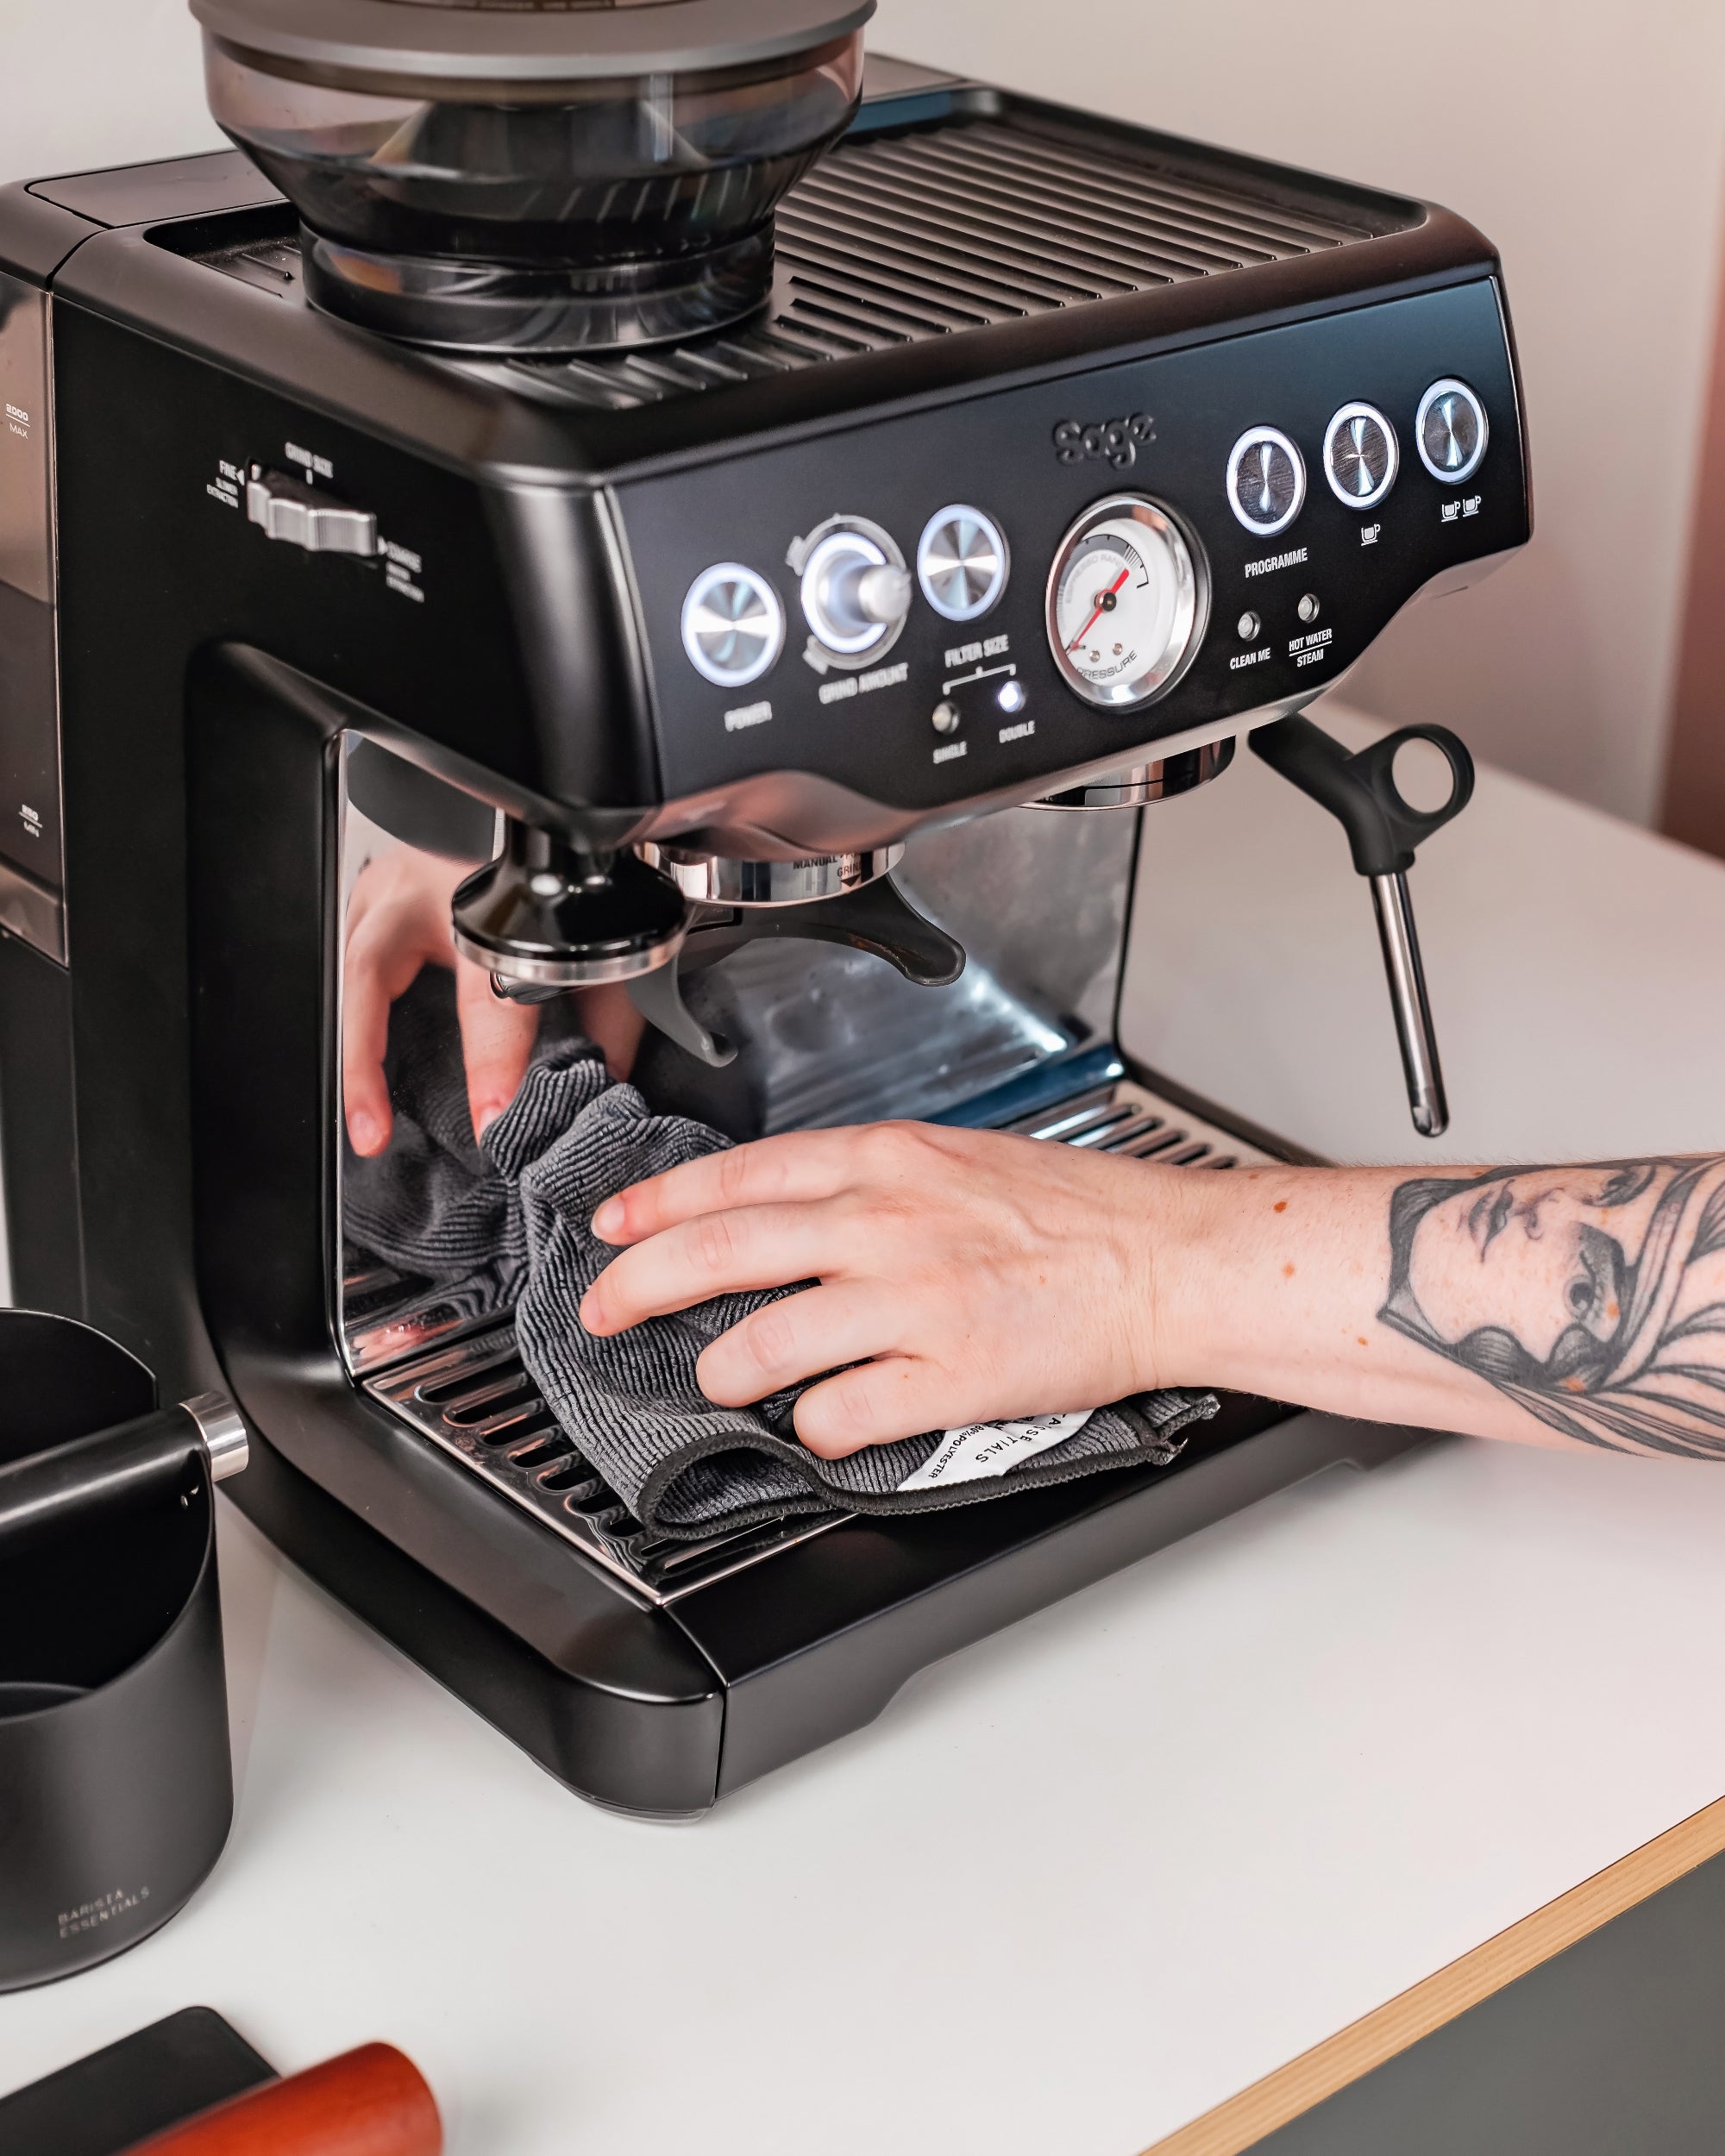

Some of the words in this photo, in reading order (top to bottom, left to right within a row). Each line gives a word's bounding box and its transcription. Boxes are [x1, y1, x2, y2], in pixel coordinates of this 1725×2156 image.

[6, 403, 28, 422] 2000
[9, 423, 28, 439] MAX
[1245, 547, 1308, 578] PROGRAMME
[1289, 637, 1305, 651] HOT
[1305, 628, 1333, 647] WATER
[1076, 649, 1138, 680] PRESSURE
[1229, 651, 1257, 670] CLEAN
[1258, 648, 1271, 661] ME
[1296, 649, 1324, 667] STEAM
